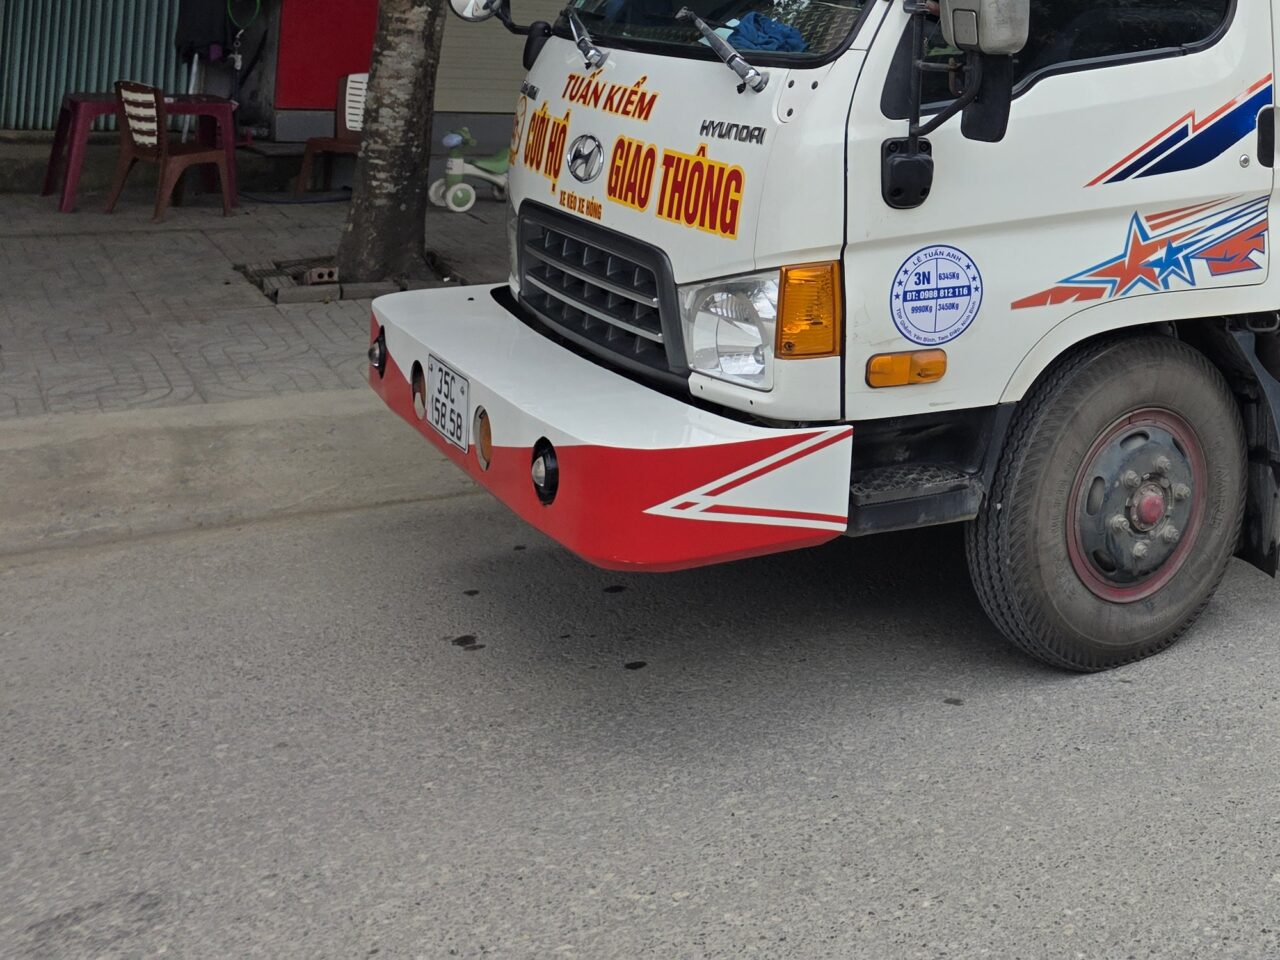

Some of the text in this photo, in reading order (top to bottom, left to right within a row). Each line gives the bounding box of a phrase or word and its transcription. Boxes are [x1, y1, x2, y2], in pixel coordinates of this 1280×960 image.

[561, 69, 607, 109] TUẤN
[602, 75, 660, 123] KIỂM
[700, 119, 767, 145] HYUNDAI
[523, 100, 745, 239] CỨU HỘ GIAO THÔNG
[912, 248, 962, 267] LÊ TUẤN ANH
[914, 271, 931, 286] 3N
[919, 289, 938, 300] 0988
[939, 287, 953, 297] 812
[954, 286, 968, 296] 116
[437, 367, 455, 405] 35C
[431, 394, 463, 442] 158.58
